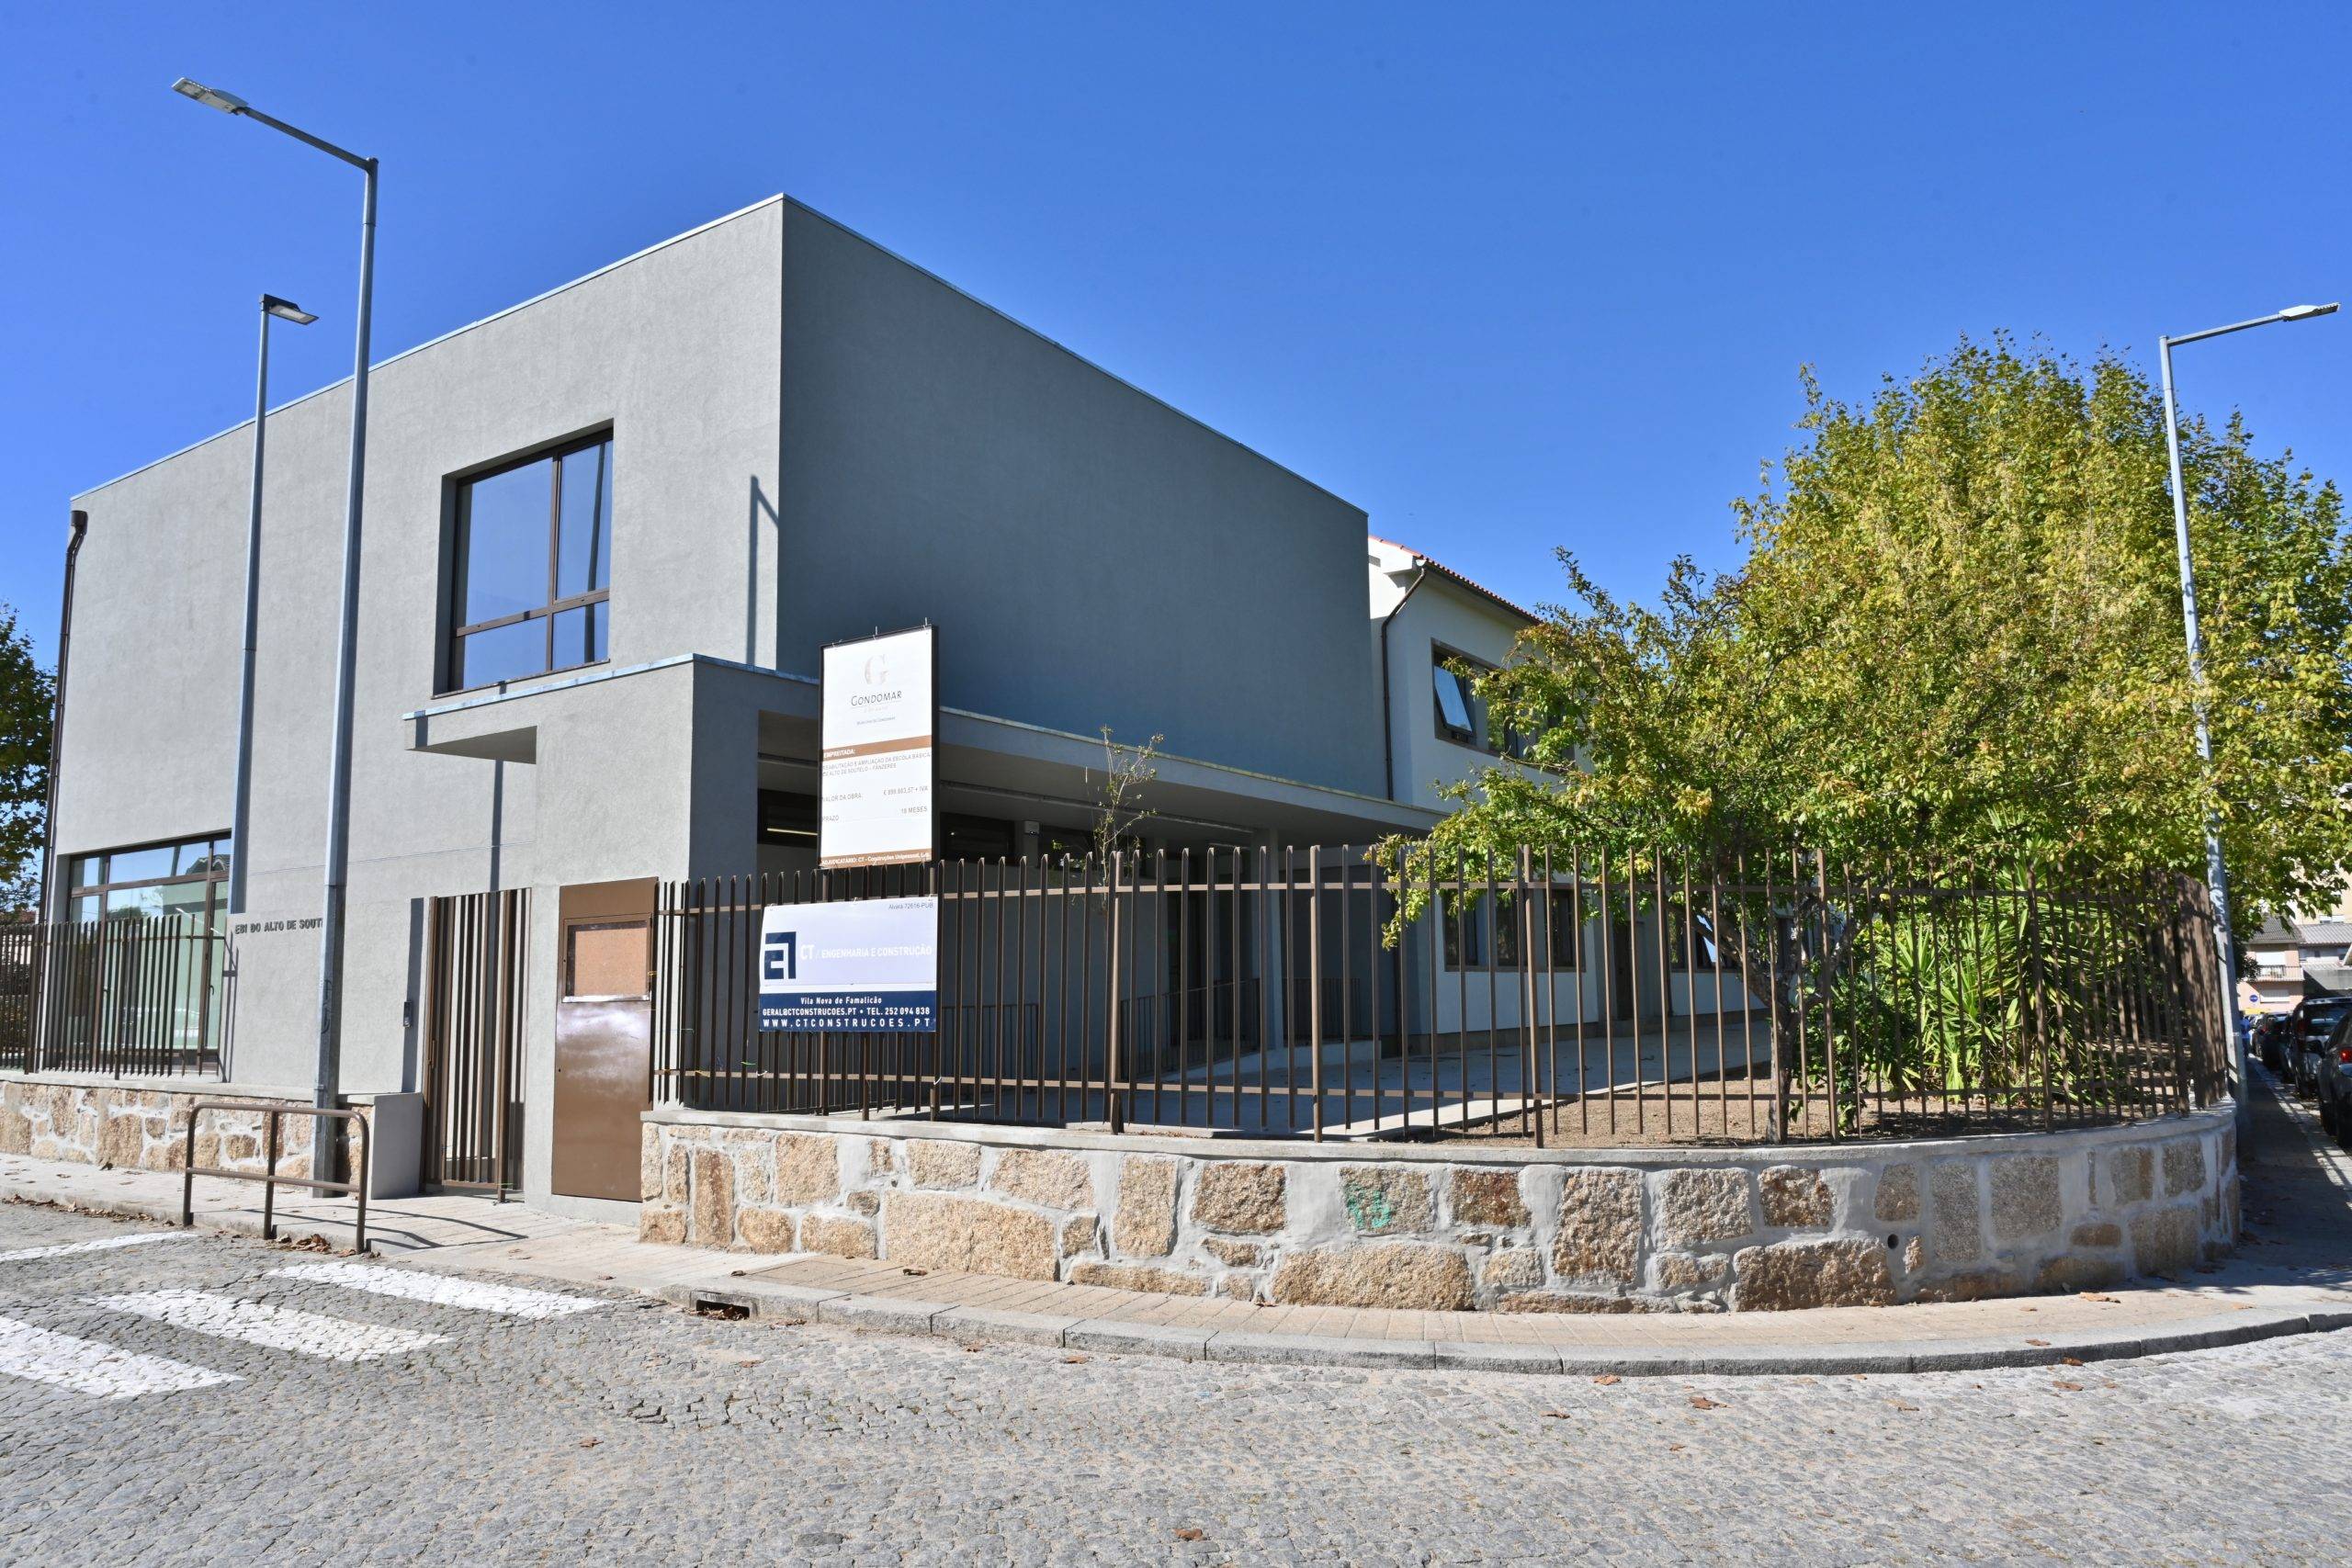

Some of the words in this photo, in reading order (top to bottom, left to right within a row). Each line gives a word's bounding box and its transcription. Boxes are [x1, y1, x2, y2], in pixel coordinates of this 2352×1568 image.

[851, 691, 902, 706] GONDOMAR
[908, 806, 928, 814] MESES
[250, 922, 261, 933] DO
[264, 920, 285, 932] ALTO
[287, 919, 297, 931] DE
[800, 944, 815, 960] CT
[821, 947, 869, 958] ENGENHARIA
[877, 943, 933, 958] CONSTRUÇÃO
[800, 997, 813, 1005] Vila
[816, 997, 832, 1005] Nova
[845, 996, 882, 1004] Famalicão
[763, 1007, 856, 1016] GERAL@CTCONSTRUCOES.PT
[866, 1007, 883, 1015] TEL.
[885, 1007, 898, 1015] 252
[899, 1007, 914, 1015] 094
[915, 1007, 930, 1015] 838
